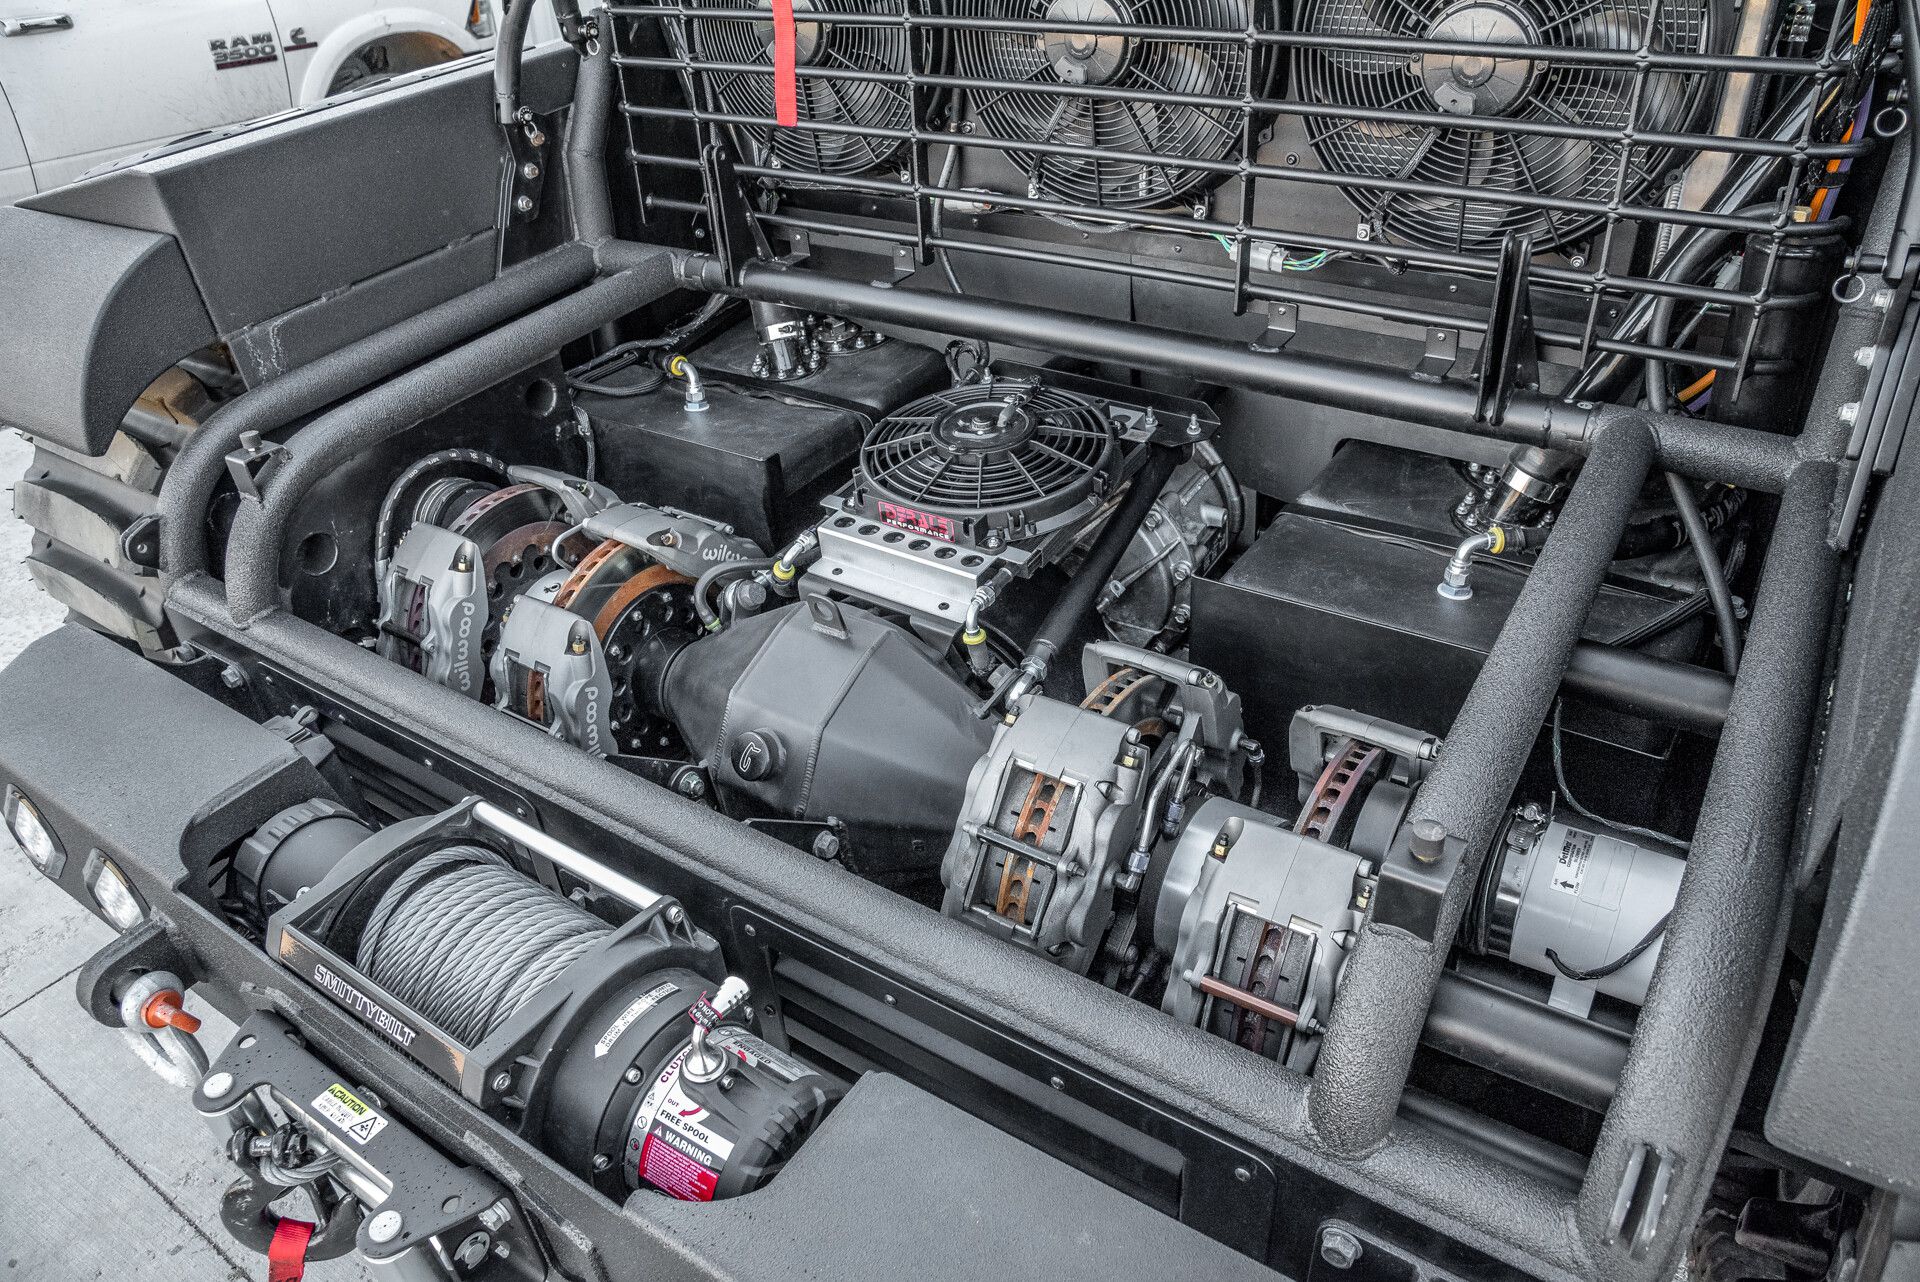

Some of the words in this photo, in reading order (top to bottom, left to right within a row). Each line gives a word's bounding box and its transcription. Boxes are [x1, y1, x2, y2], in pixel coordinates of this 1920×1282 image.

[208, 32, 273, 51] RAM
[884, 504, 949, 534] DERALE
[886, 518, 949, 540] PERFORMANCE
[702, 544, 748, 562] wilw
[454, 601, 475, 692] wilwood
[314, 964, 416, 1047] SMITTYBILT
[601, 1024, 619, 1045] SPOOL
[620, 1008, 635, 1022] WIRE
[605, 1028, 622, 1048] DRUM
[622, 1020, 630, 1028] IN
[661, 1049, 690, 1083] CLUTC
[732, 1041, 772, 1065] ENGAGED
[333, 1089, 368, 1116] CAUTION
[667, 1098, 680, 1108] OUT
[660, 1109, 683, 1127] FREE
[682, 1122, 710, 1144] SPOOL
[664, 1130, 714, 1167] WARNING
